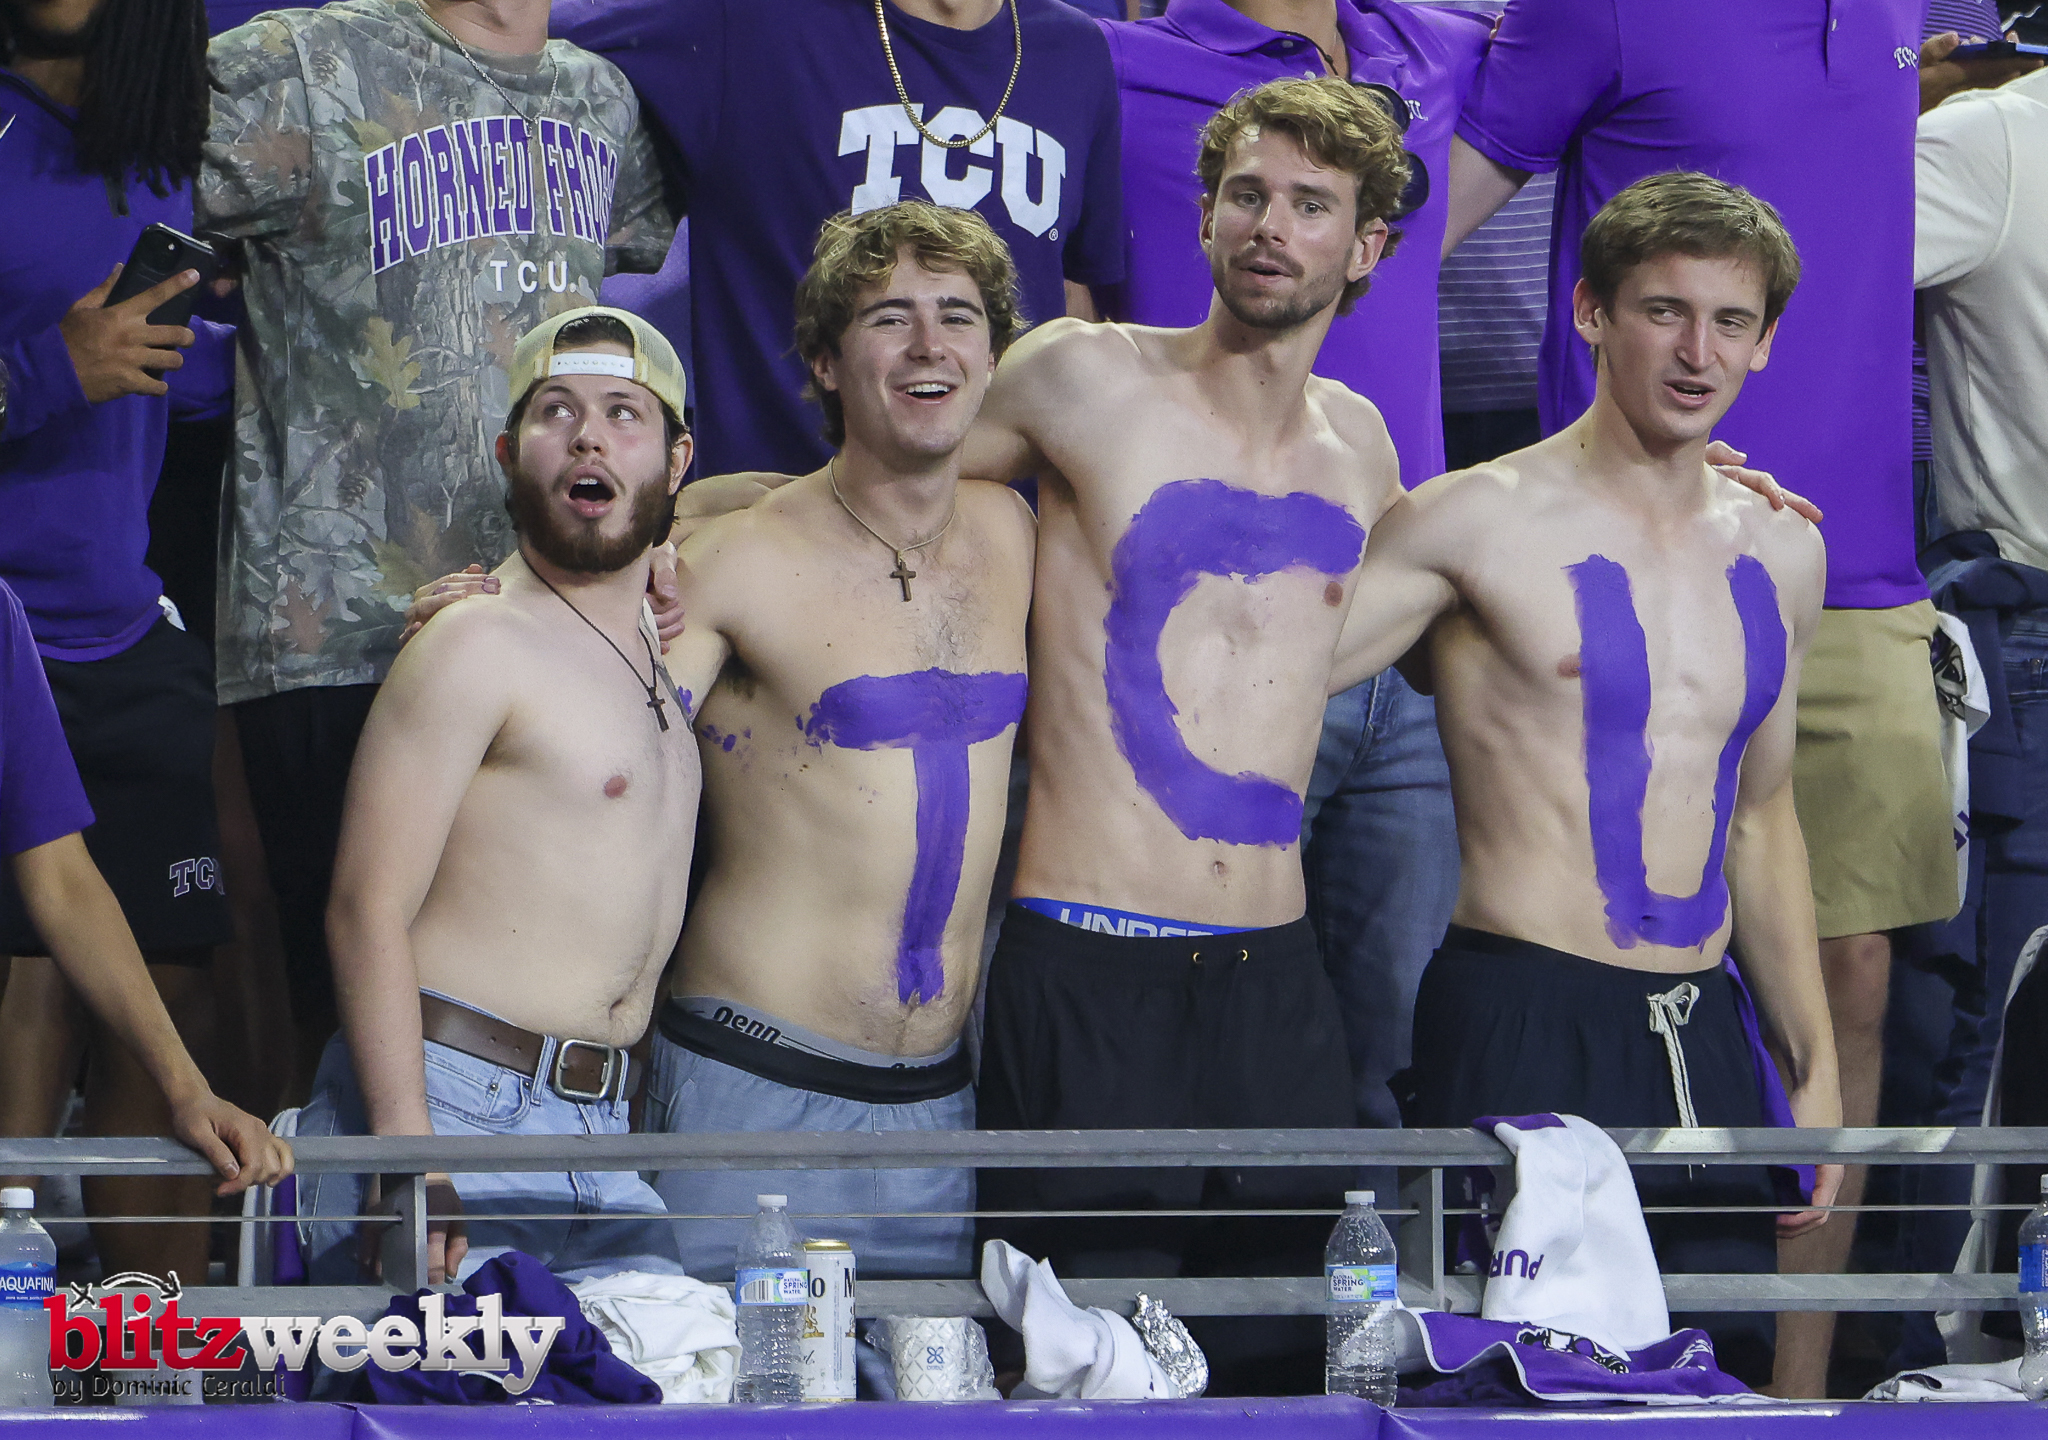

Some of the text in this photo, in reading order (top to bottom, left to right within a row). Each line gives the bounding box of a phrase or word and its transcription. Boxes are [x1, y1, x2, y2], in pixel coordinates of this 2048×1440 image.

[364, 115, 536, 275] HORNED
[838, 103, 1066, 238] TCU
[490, 260, 570, 293] TCU
[1106, 478, 1366, 849] C
[1562, 554, 1787, 949] U
[798, 667, 1029, 1005] T
[0, 1276, 55, 1293] AQUAFINA
[783, 1282, 808, 1290] SPRING
[1333, 1279, 1364, 1287] SPRING
